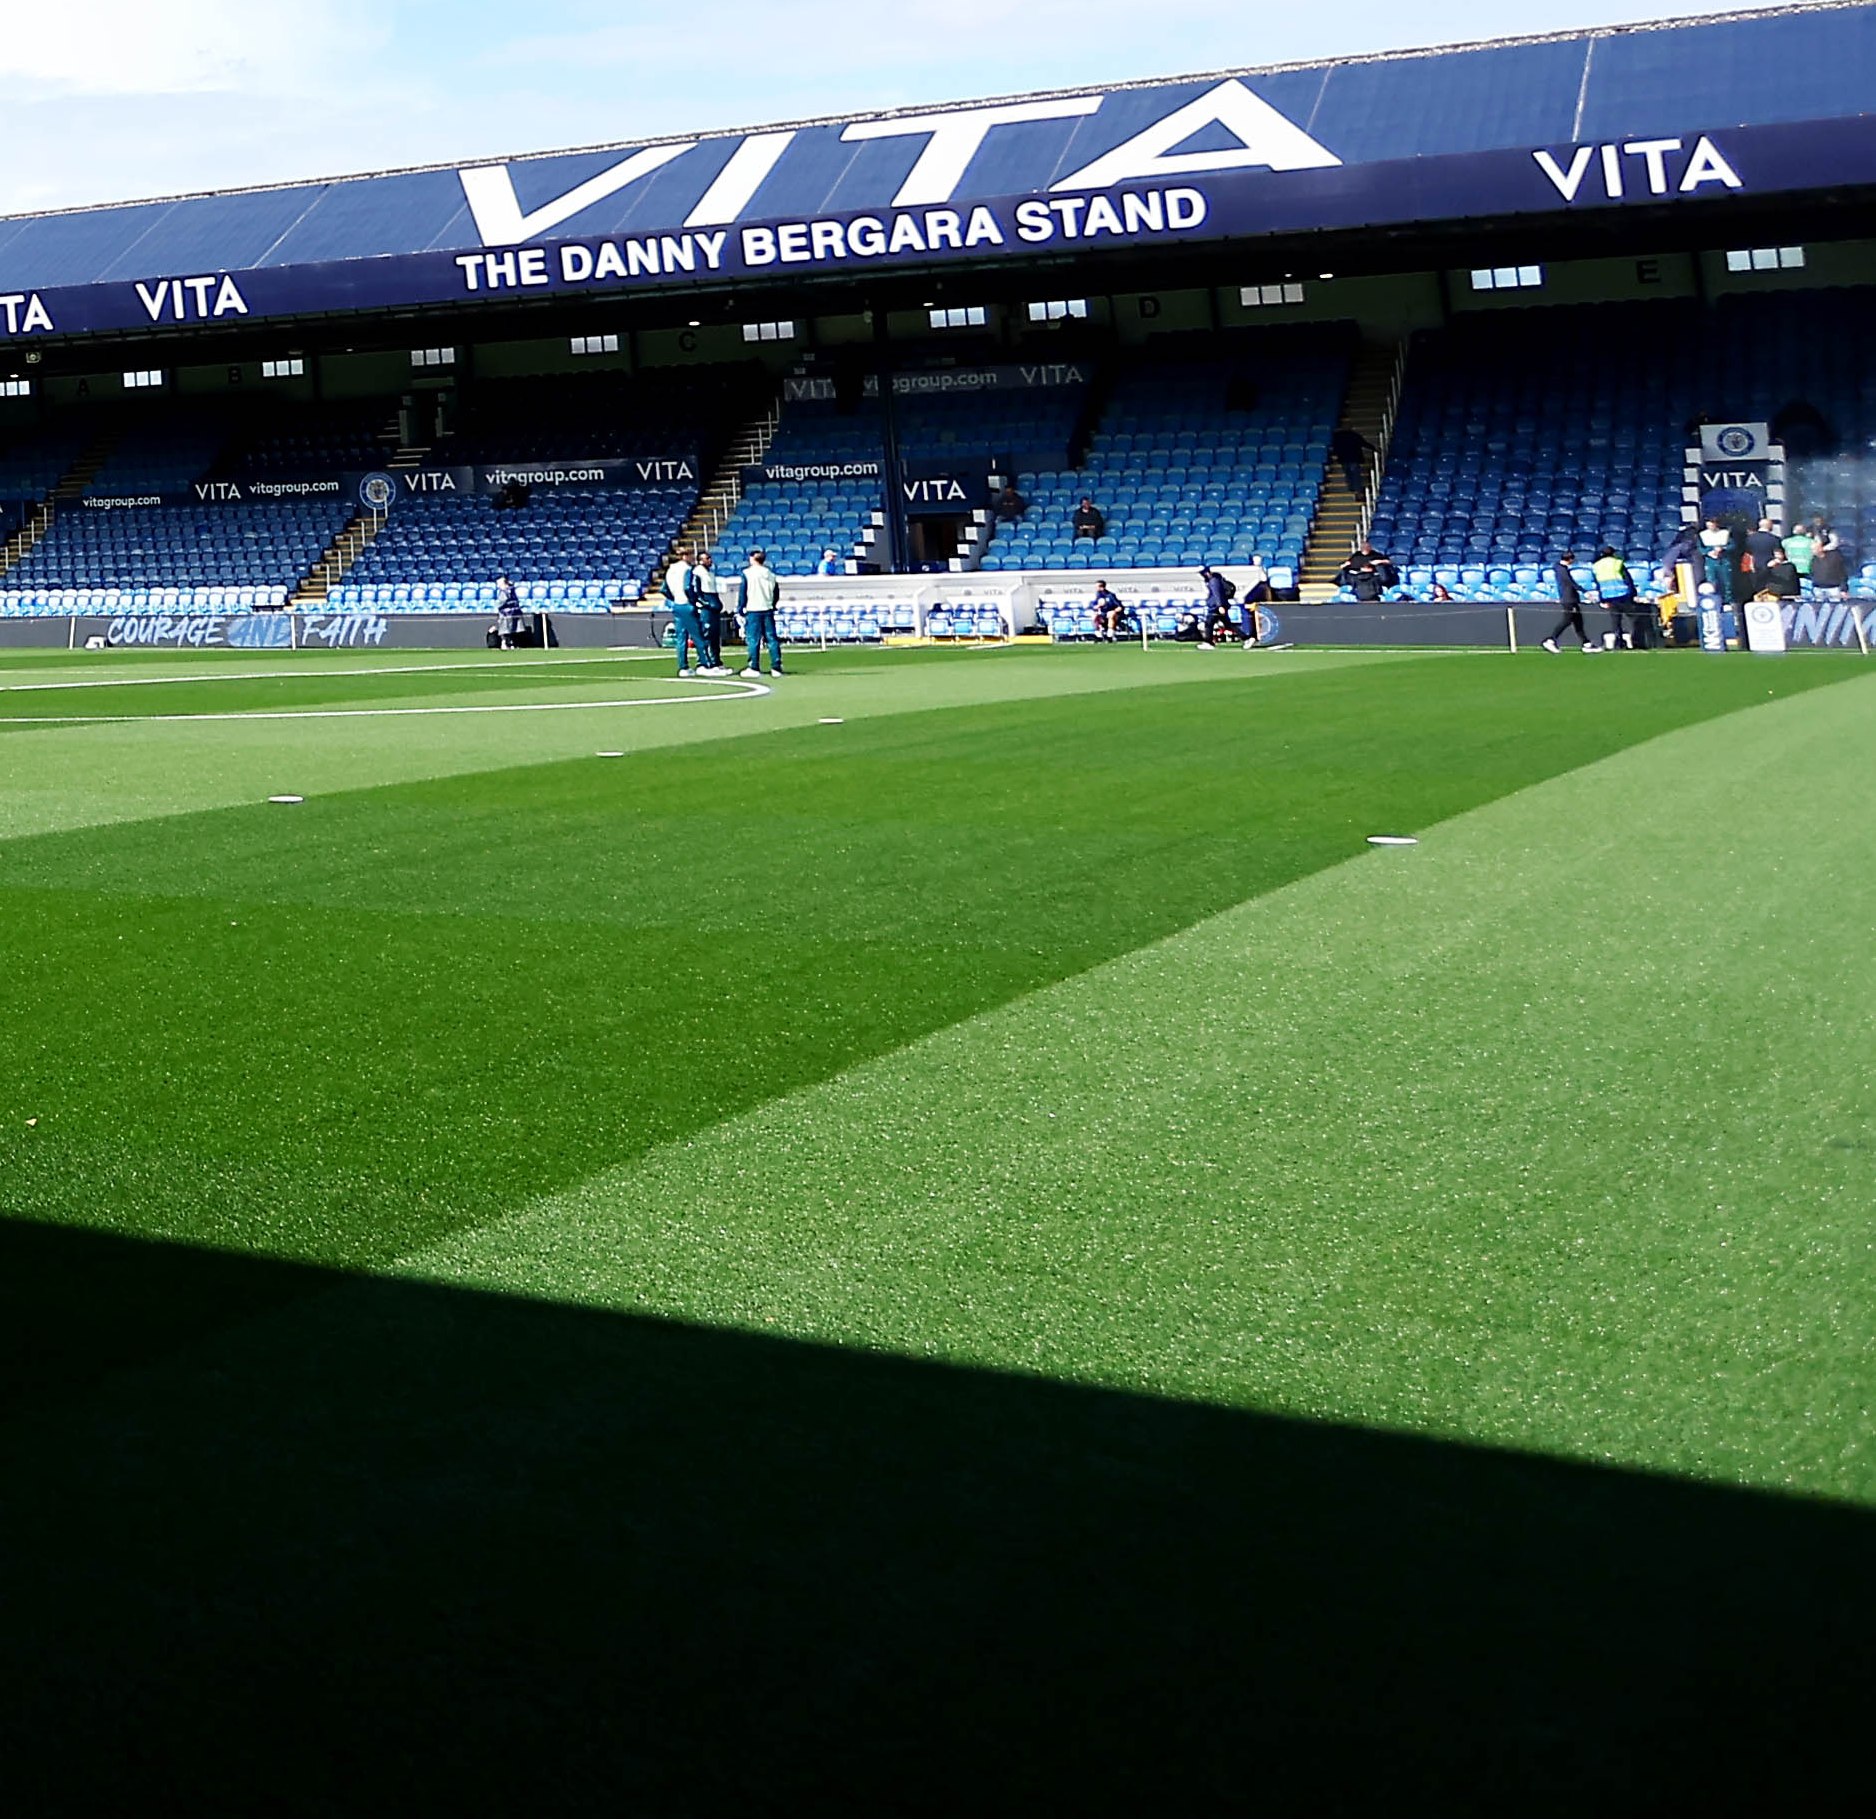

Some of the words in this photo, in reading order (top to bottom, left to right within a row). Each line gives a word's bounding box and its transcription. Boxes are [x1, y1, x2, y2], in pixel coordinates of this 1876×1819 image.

[458, 78, 1344, 247] VITA
[1531, 135, 1744, 202] VITA
[455, 252, 549, 291] THE
[561, 229, 727, 283] DANNY
[742, 204, 1005, 267] BERGARA
[1016, 186, 1208, 243] STAND
[1638, 260, 1661, 284] E
[135, 274, 248, 321] VITA
[1139, 296, 1160, 318] D
[679, 331, 697, 352] C
[791, 378, 837, 398] VIT
[863, 370, 998, 394] vigroup.com
[1020, 364, 1084, 385] VITA
[404, 472, 456, 492] VITA
[635, 461, 694, 481] VITA
[765, 461, 879, 482] vitagroup.com
[903, 480, 967, 502] VITA
[1703, 472, 1763, 488] VITA
[82, 494, 161, 511] vitagroup.com
[194, 482, 242, 501] VITA
[249, 479, 339, 496] vitagroup.com
[107, 614, 226, 647] COURAGE
[228, 615, 292, 647] AND
[300, 615, 388, 646] FAITH
